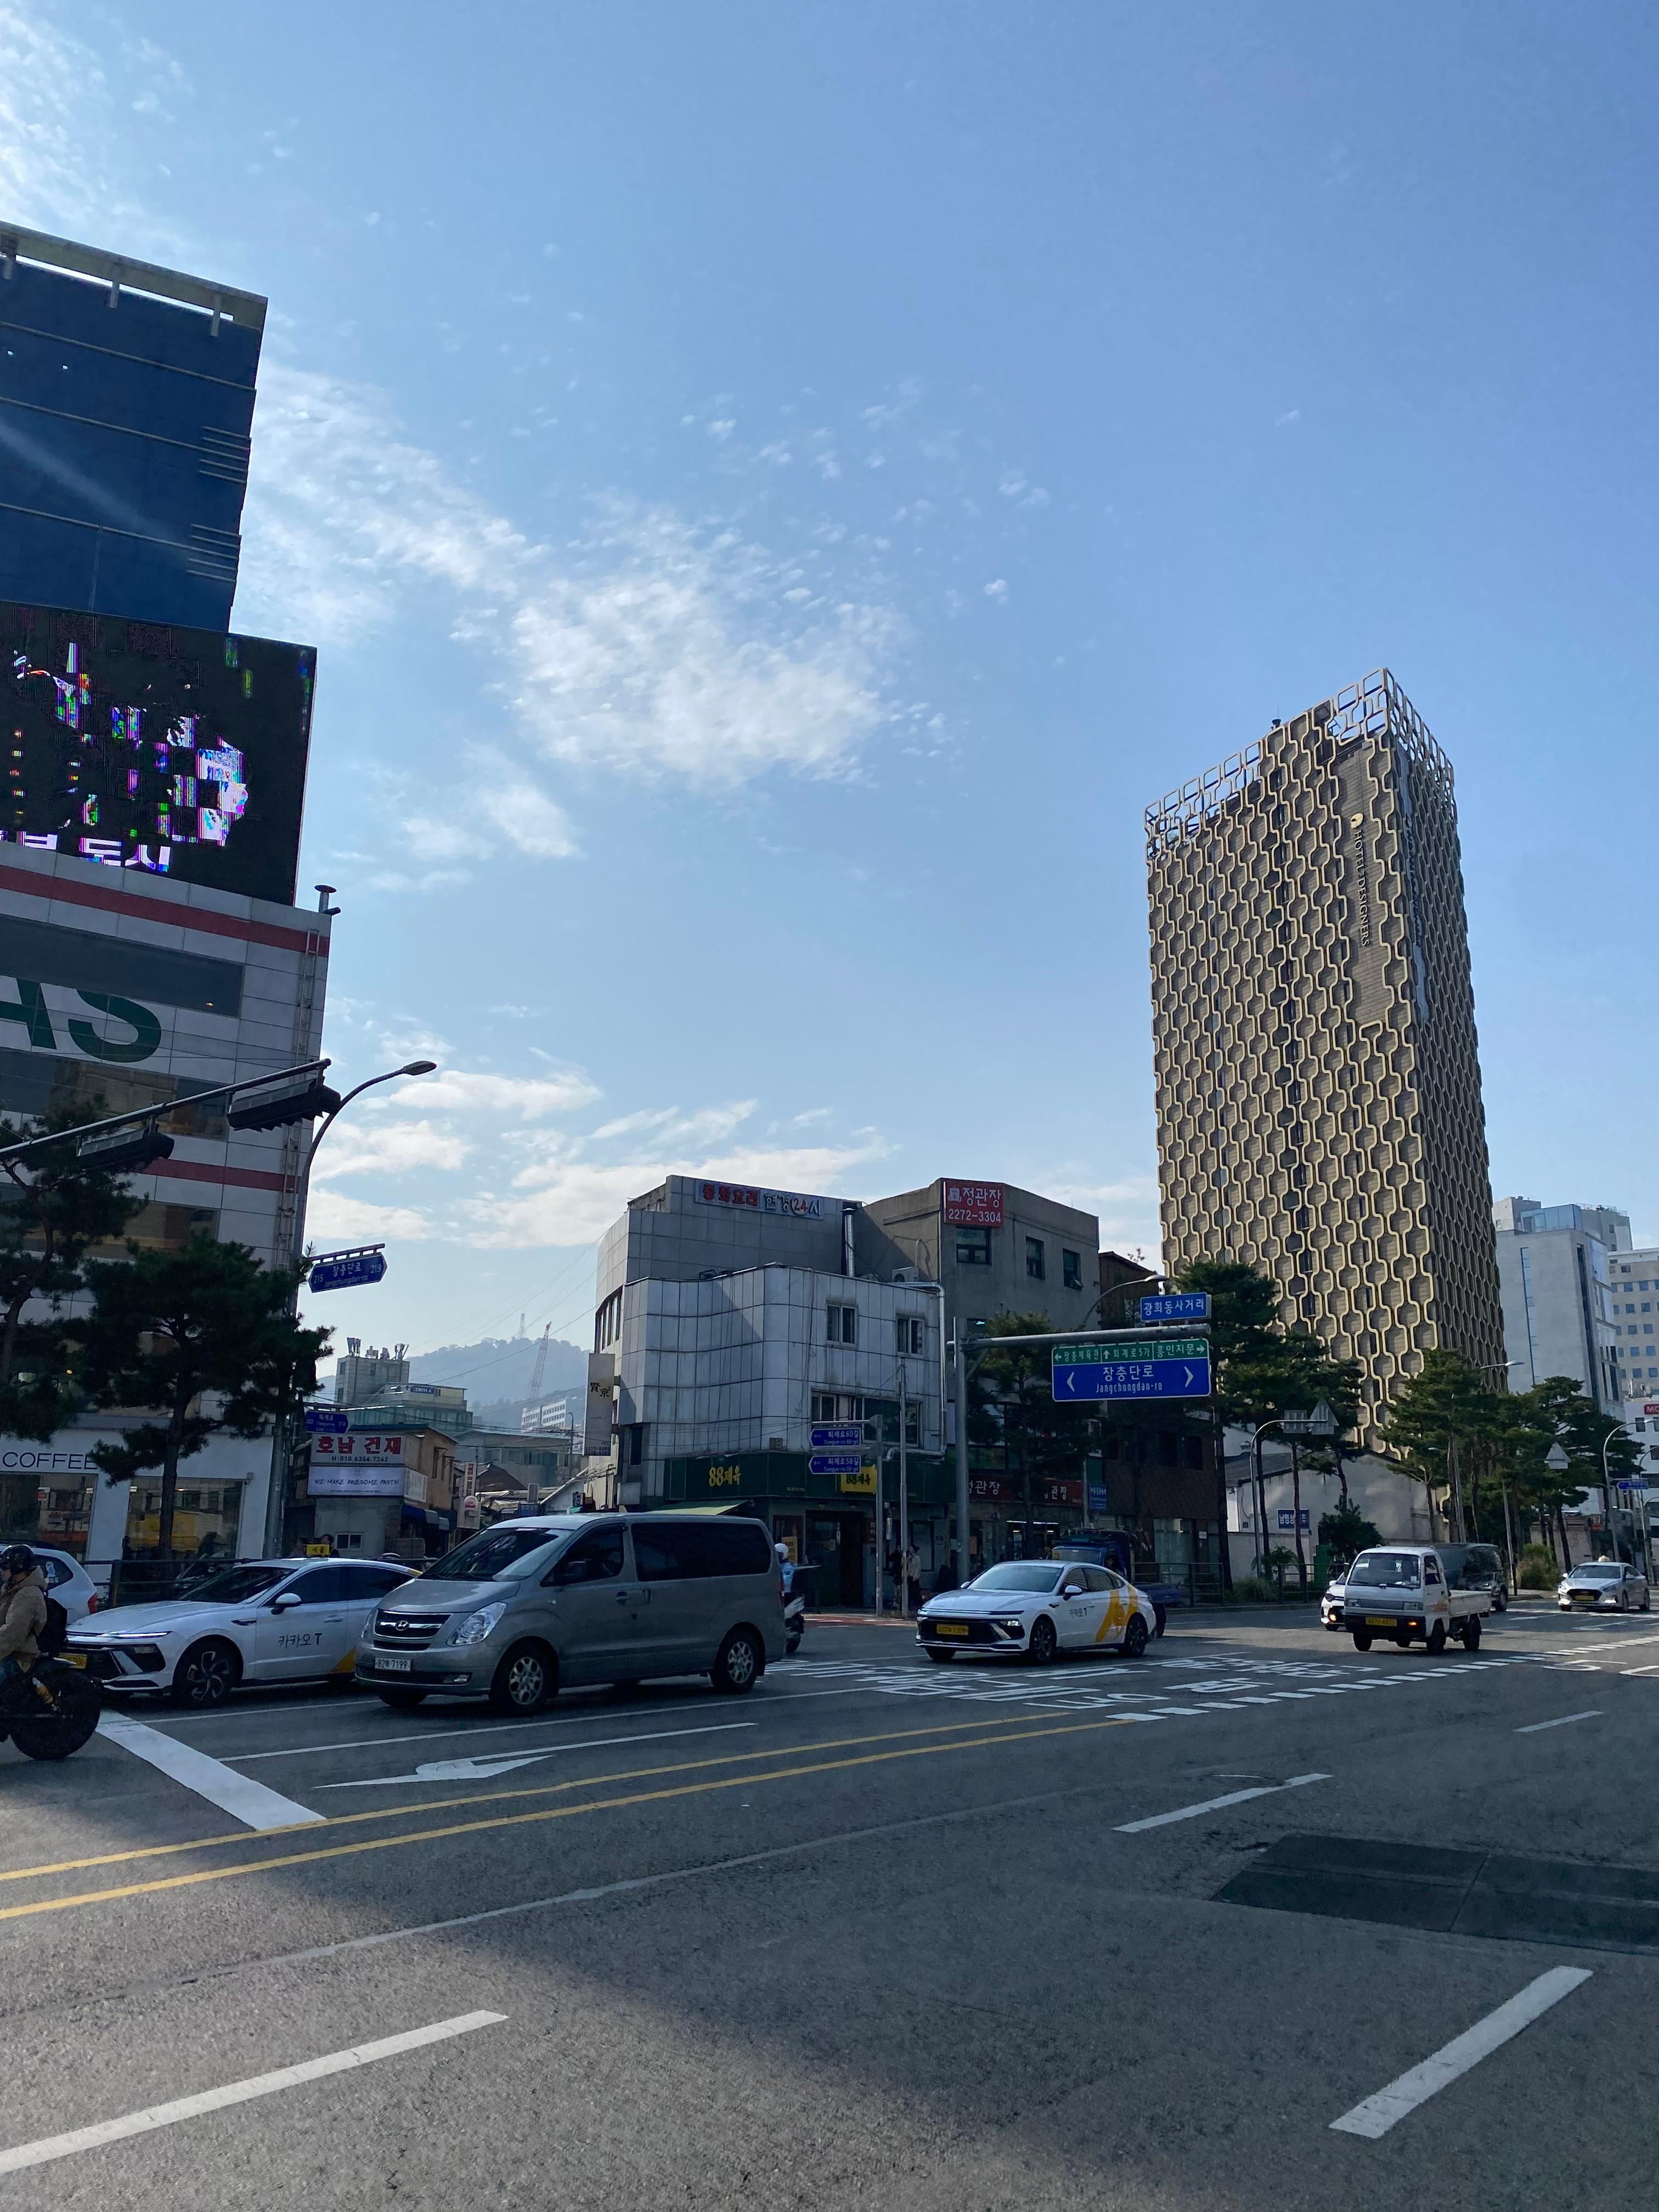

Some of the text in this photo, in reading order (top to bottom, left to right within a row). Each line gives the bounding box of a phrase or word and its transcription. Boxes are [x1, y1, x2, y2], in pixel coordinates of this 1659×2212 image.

[1354, 830, 1370, 947] HOTEL DESIGNERS
[962, 1187, 1001, 1208] 정관장
[948, 1209, 1001, 1223] 2272-3304
[332, 1262, 362, 1277] 장충단로
[370, 1263, 382, 1274] 219
[313, 1274, 324, 1283] 215
[1143, 1298, 1204, 1316] 광희동사거리
[1063, 1350, 1099, 1362] 장충체육관
[1113, 1347, 1150, 1359] 퇴계로5가
[1103, 1364, 1154, 1381] 장충단로
[1096, 1382, 1163, 1395] Jangchungdan-ro
[828, 1430, 859, 1438] 퇴계로60길
[316, 1436, 402, 1454] 호남 건재
[828, 1457, 859, 1465] 퇴계로58길
[1044, 1485, 1067, 1500] 관장
[391, 1660, 408, 1669] 7199
